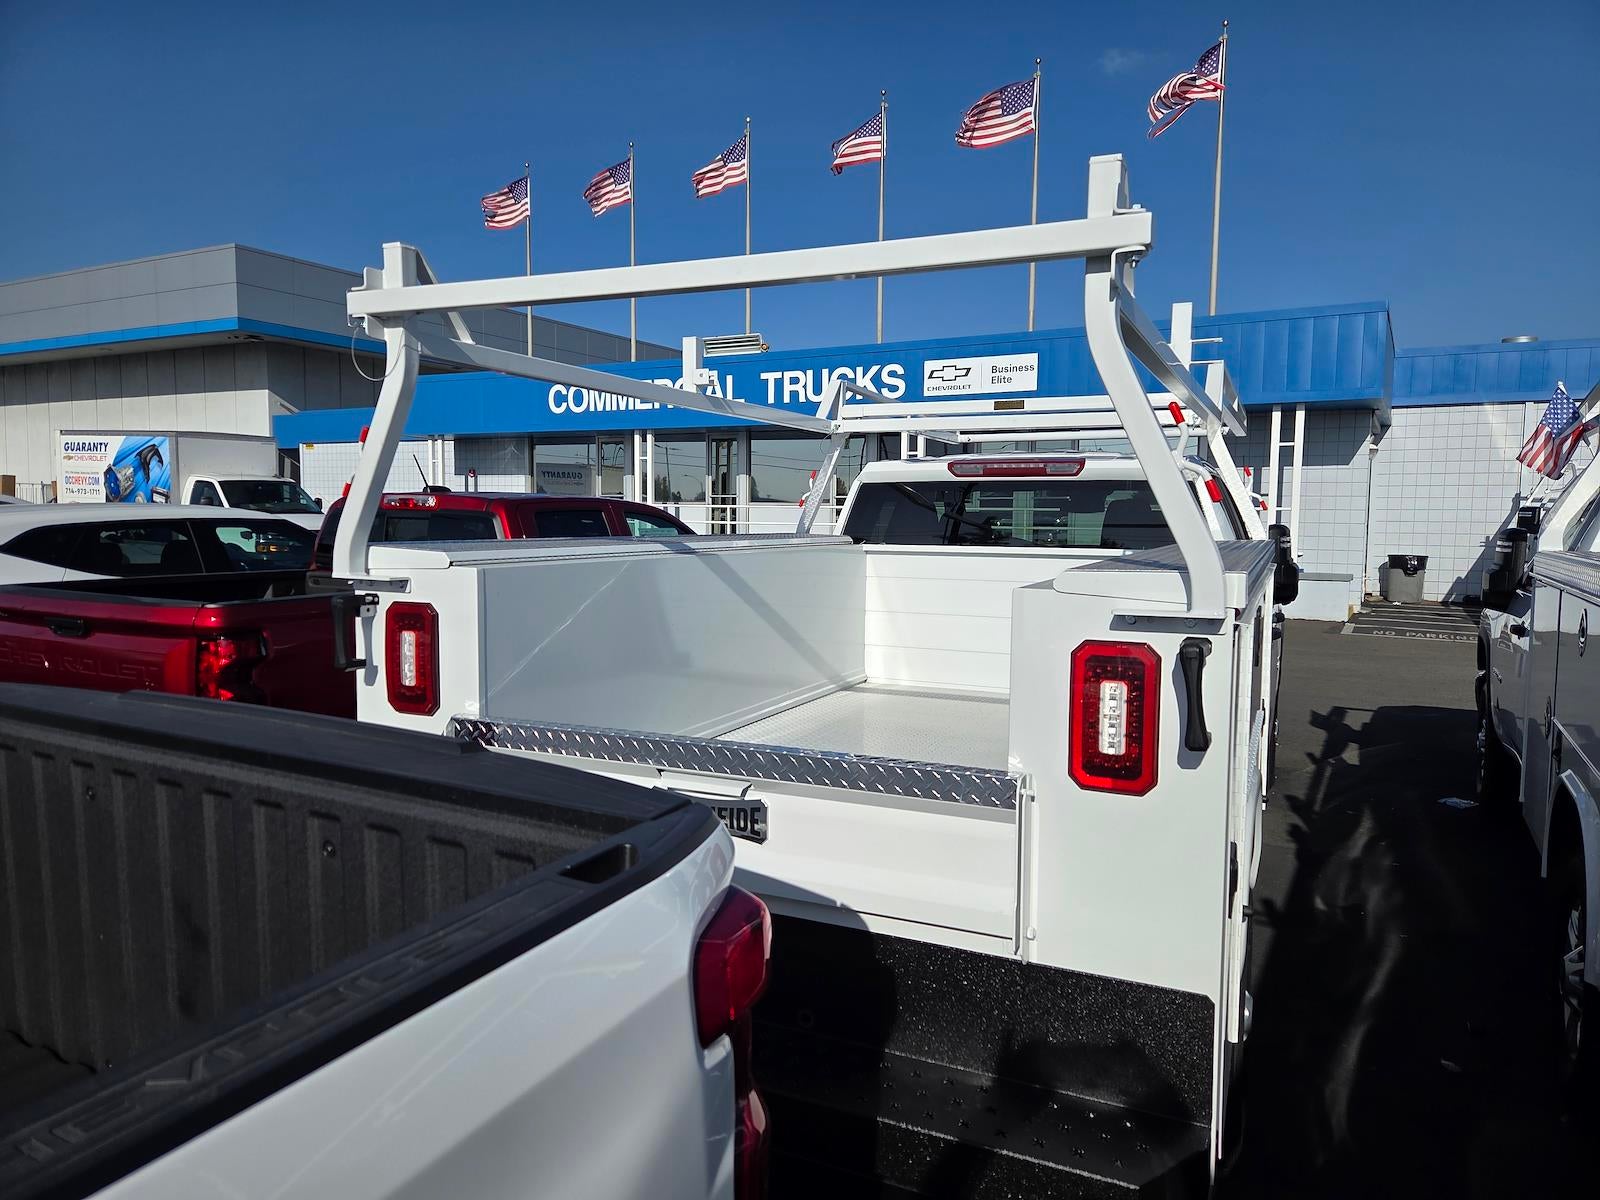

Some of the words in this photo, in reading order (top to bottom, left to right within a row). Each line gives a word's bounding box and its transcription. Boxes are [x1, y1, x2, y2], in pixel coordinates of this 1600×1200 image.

[991, 363, 1035, 374] Business
[991, 376, 1013, 385] Elite
[927, 384, 972, 392] CHEVROLET
[64, 441, 109, 453] GUARANTY
[65, 475, 100, 486] OCCHEVY.COM
[65, 487, 100, 496] 714-973-1711
